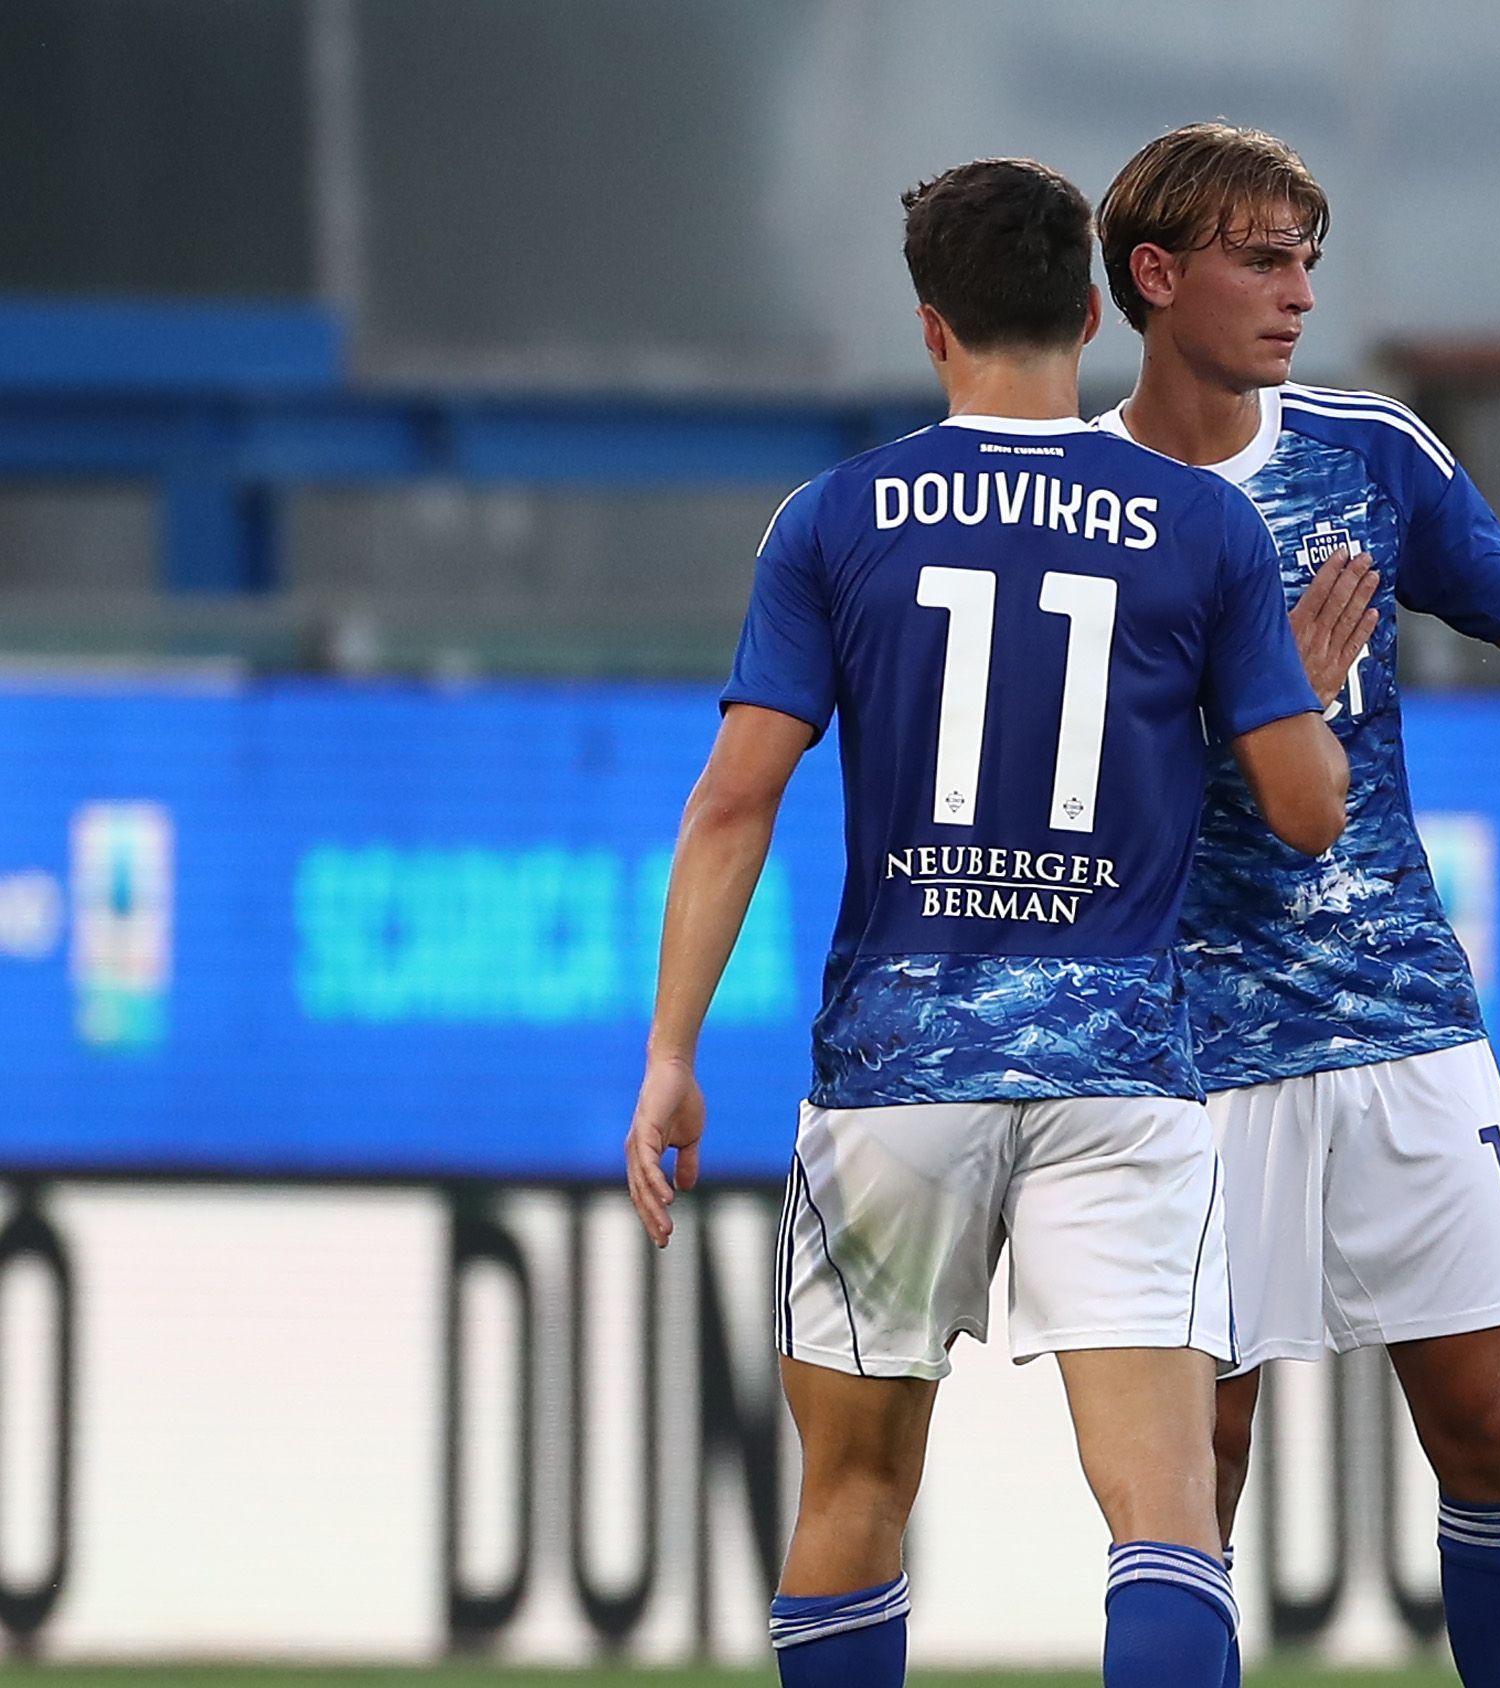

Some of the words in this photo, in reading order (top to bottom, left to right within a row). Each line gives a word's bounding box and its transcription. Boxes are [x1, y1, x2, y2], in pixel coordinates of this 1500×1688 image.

[874, 472, 1159, 550] DOUVIKAS
[915, 565, 1118, 833] 11
[886, 846, 1119, 889] NEUBERGER
[921, 887, 1079, 925] BERMAN
[448, 1190, 790, 1643] DUN
